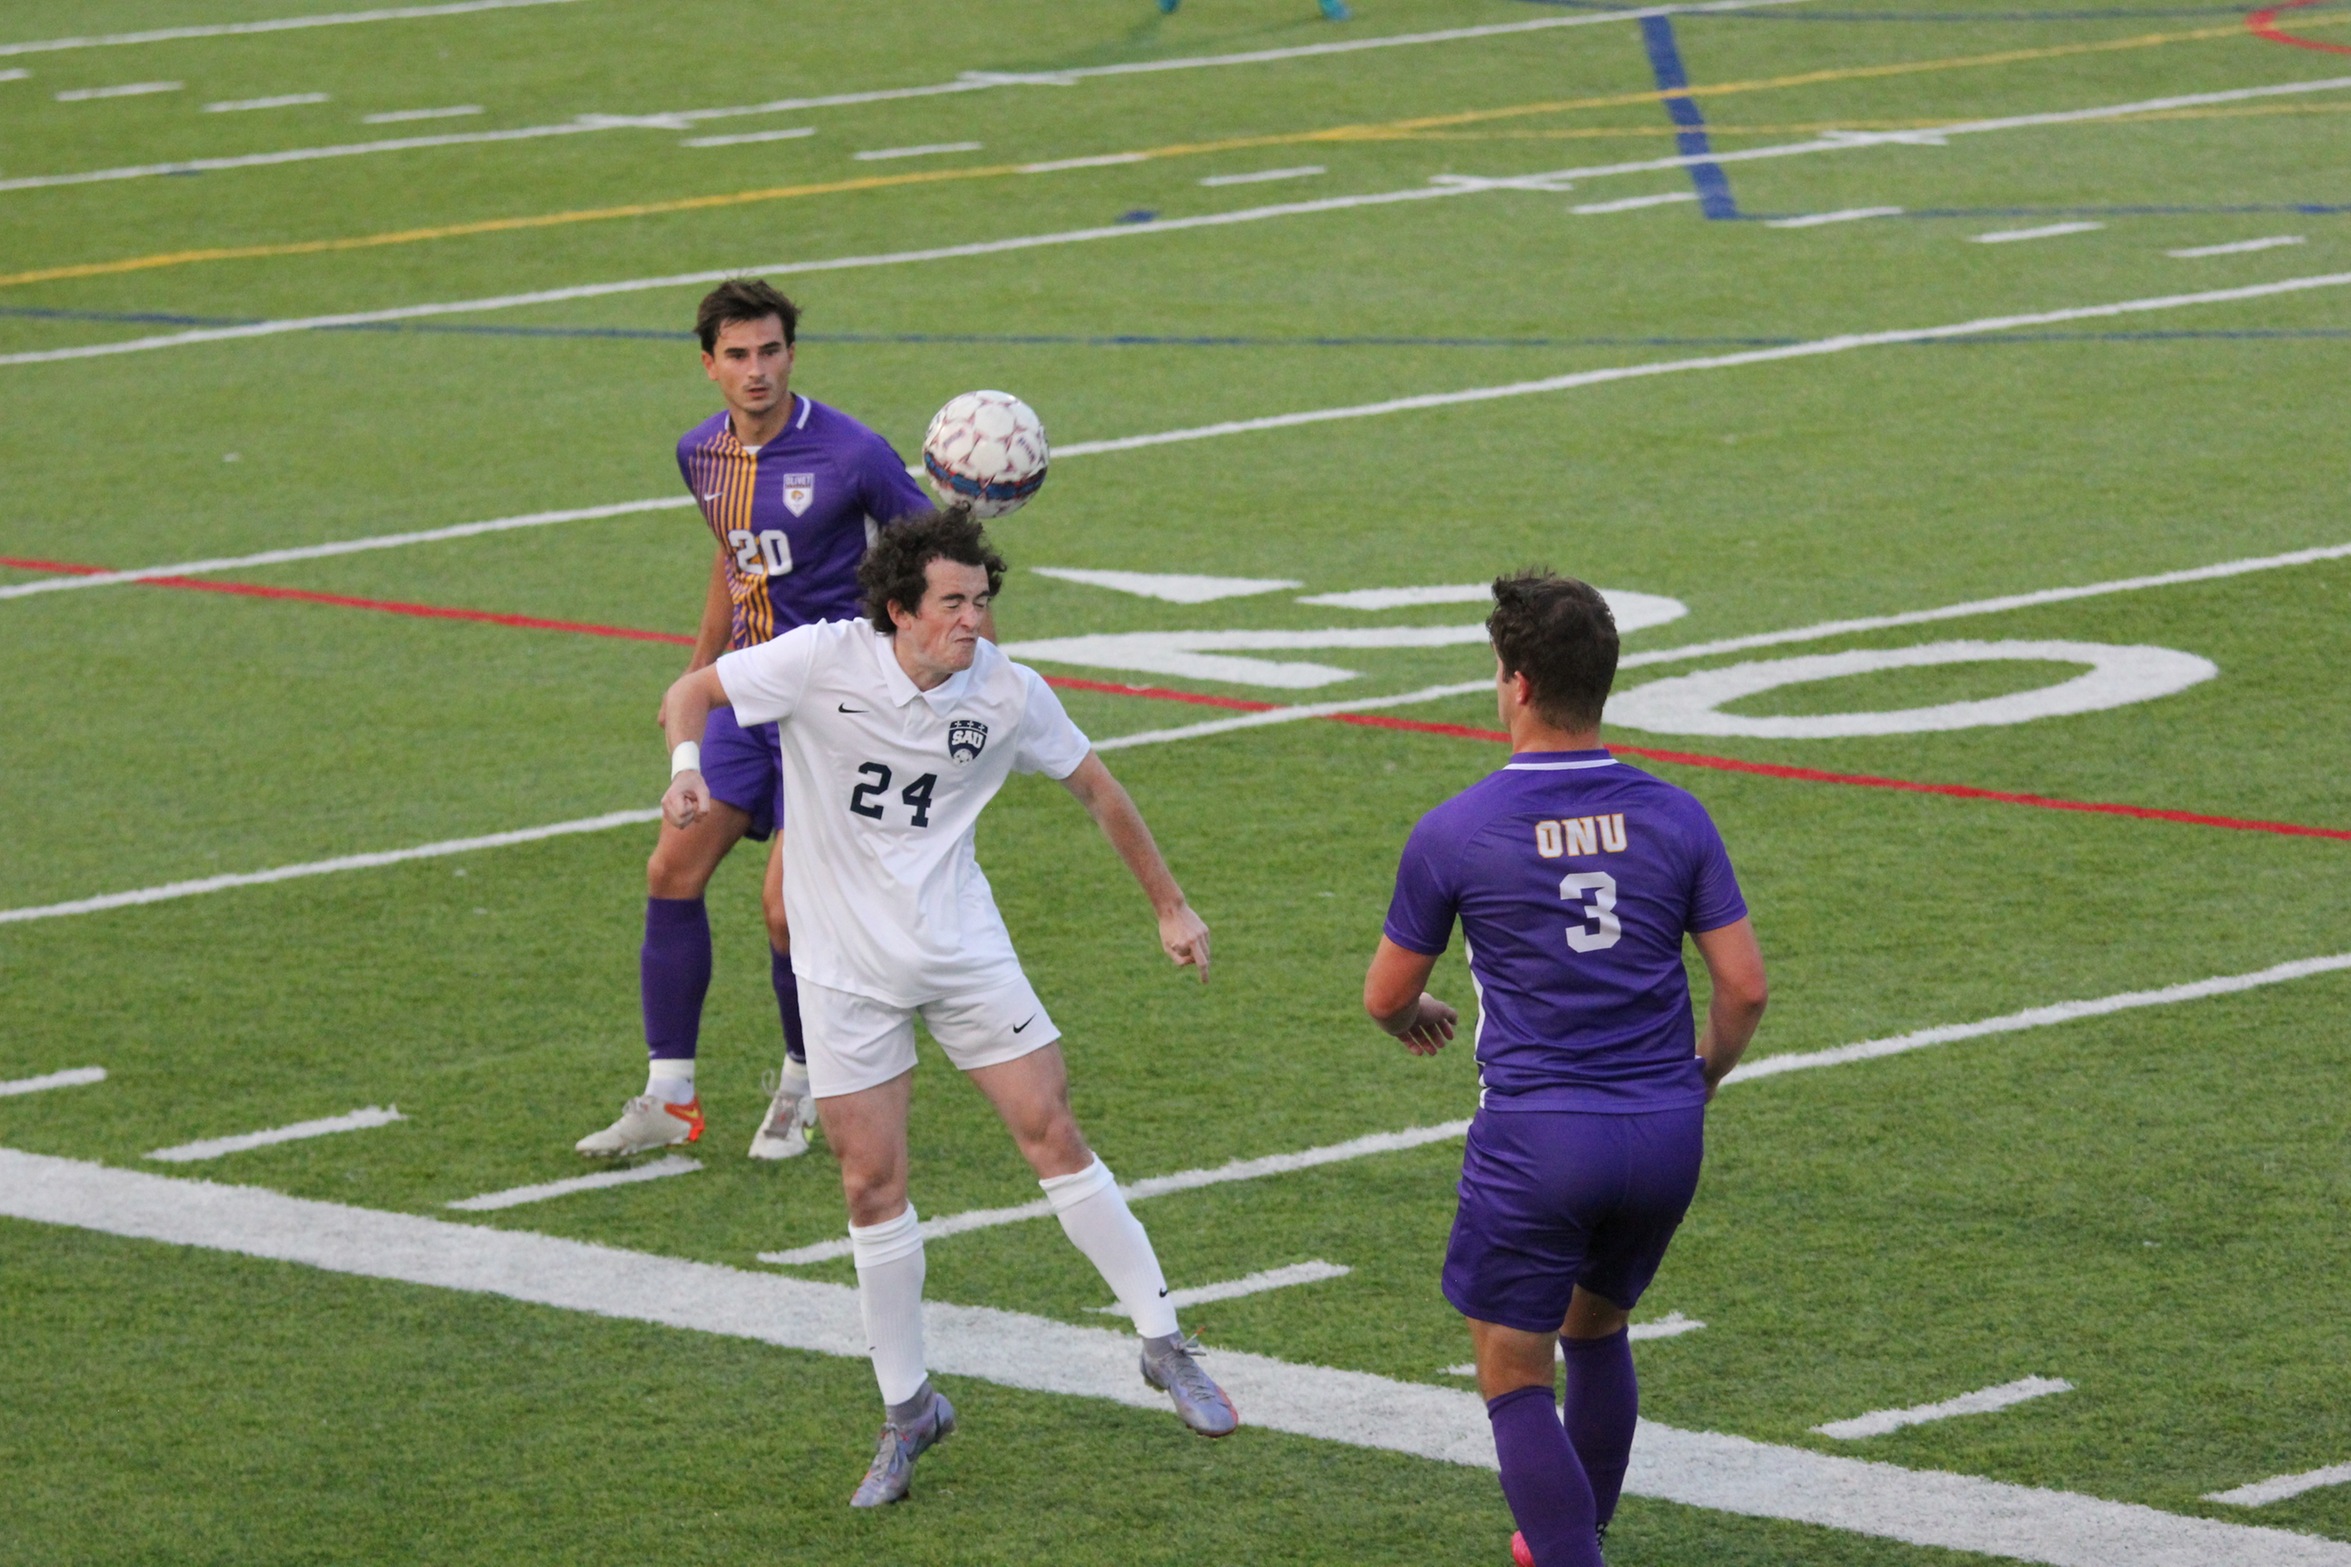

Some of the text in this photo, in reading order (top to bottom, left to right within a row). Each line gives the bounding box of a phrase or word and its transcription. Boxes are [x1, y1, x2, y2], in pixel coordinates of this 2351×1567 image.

[728, 529, 793, 577] 20
[951, 729, 984, 749] SAU
[850, 761, 938, 828] 24
[1535, 813, 1628, 859] ONU
[1559, 871, 1621, 953] 3
